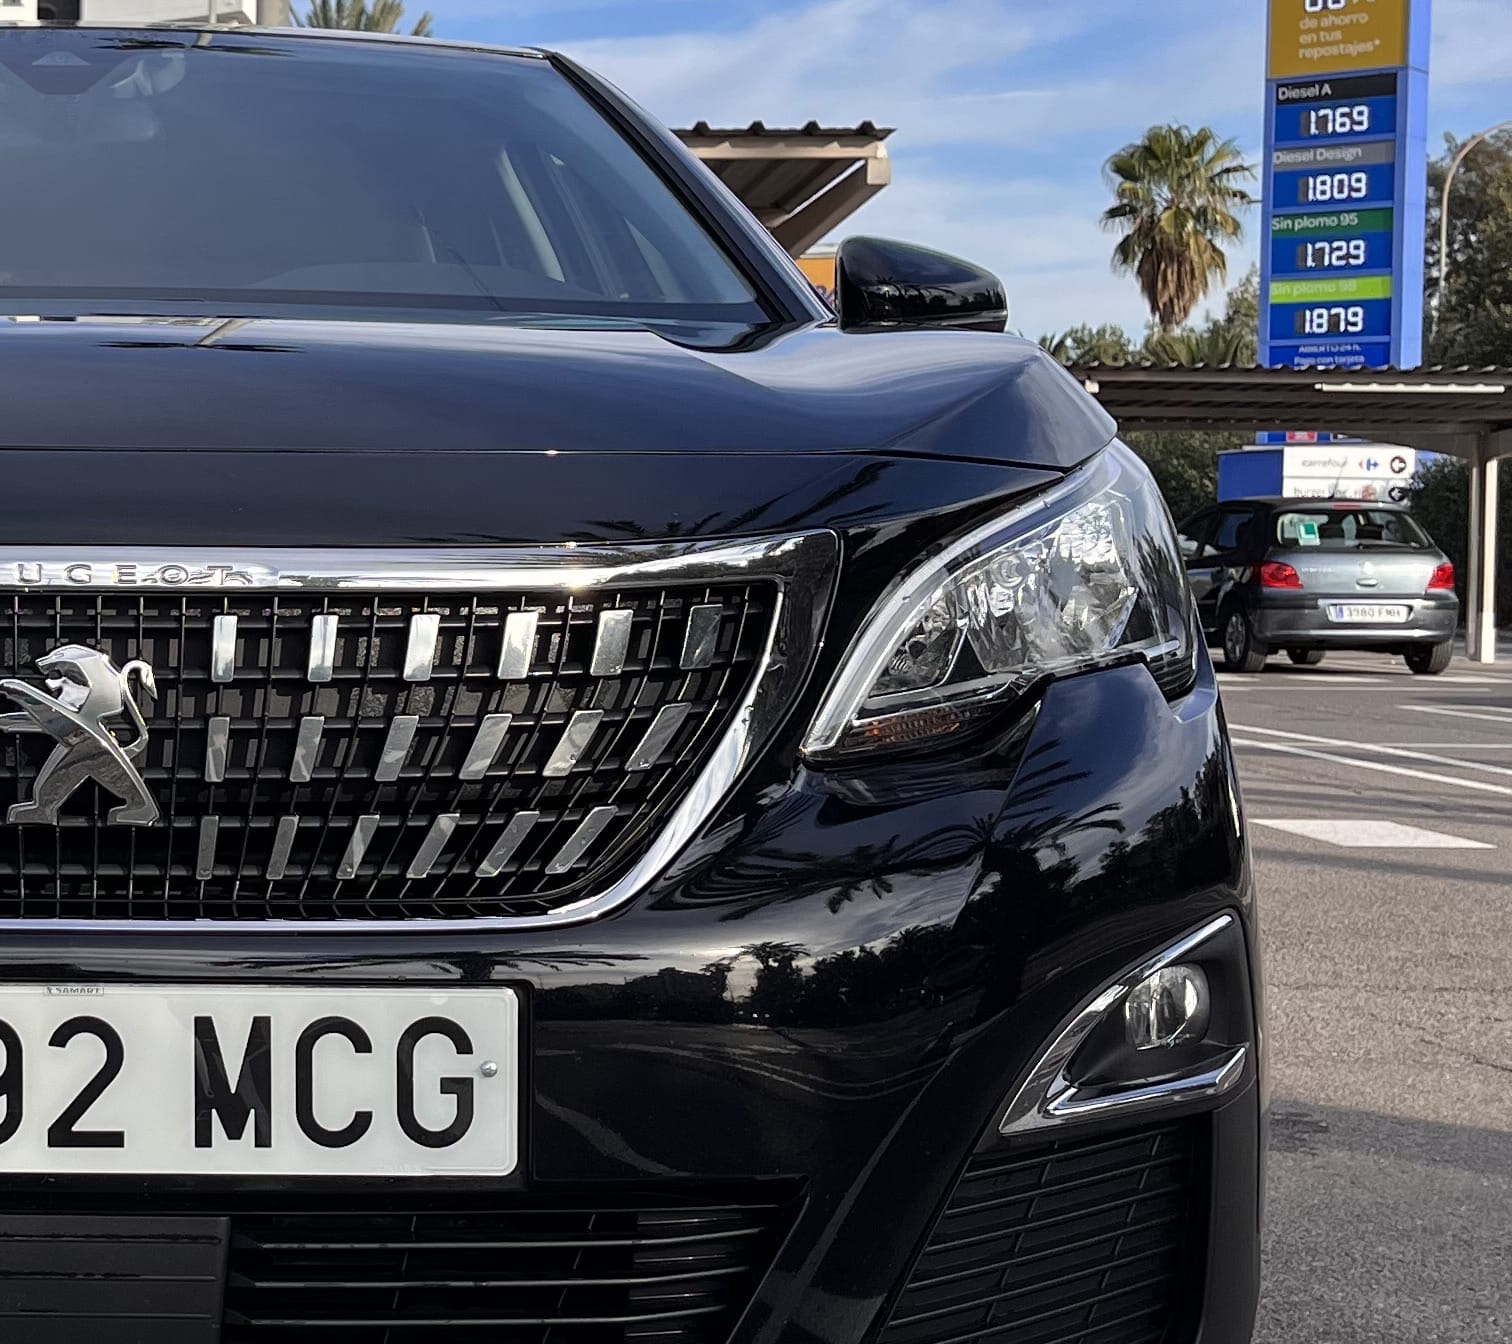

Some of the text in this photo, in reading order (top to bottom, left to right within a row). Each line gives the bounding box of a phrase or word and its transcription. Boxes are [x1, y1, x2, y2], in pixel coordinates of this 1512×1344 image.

[1299, 13, 1368, 30] de ahorro
[1299, 33, 1317, 44] en
[1278, 83, 1332, 100] Diesel A
[1273, 146, 1362, 164] Diesel Design
[1271, 213, 1358, 232] Sin plomo 95
[1293, 280, 1337, 297] plomo
[194, 1016, 474, 1148] MCG
